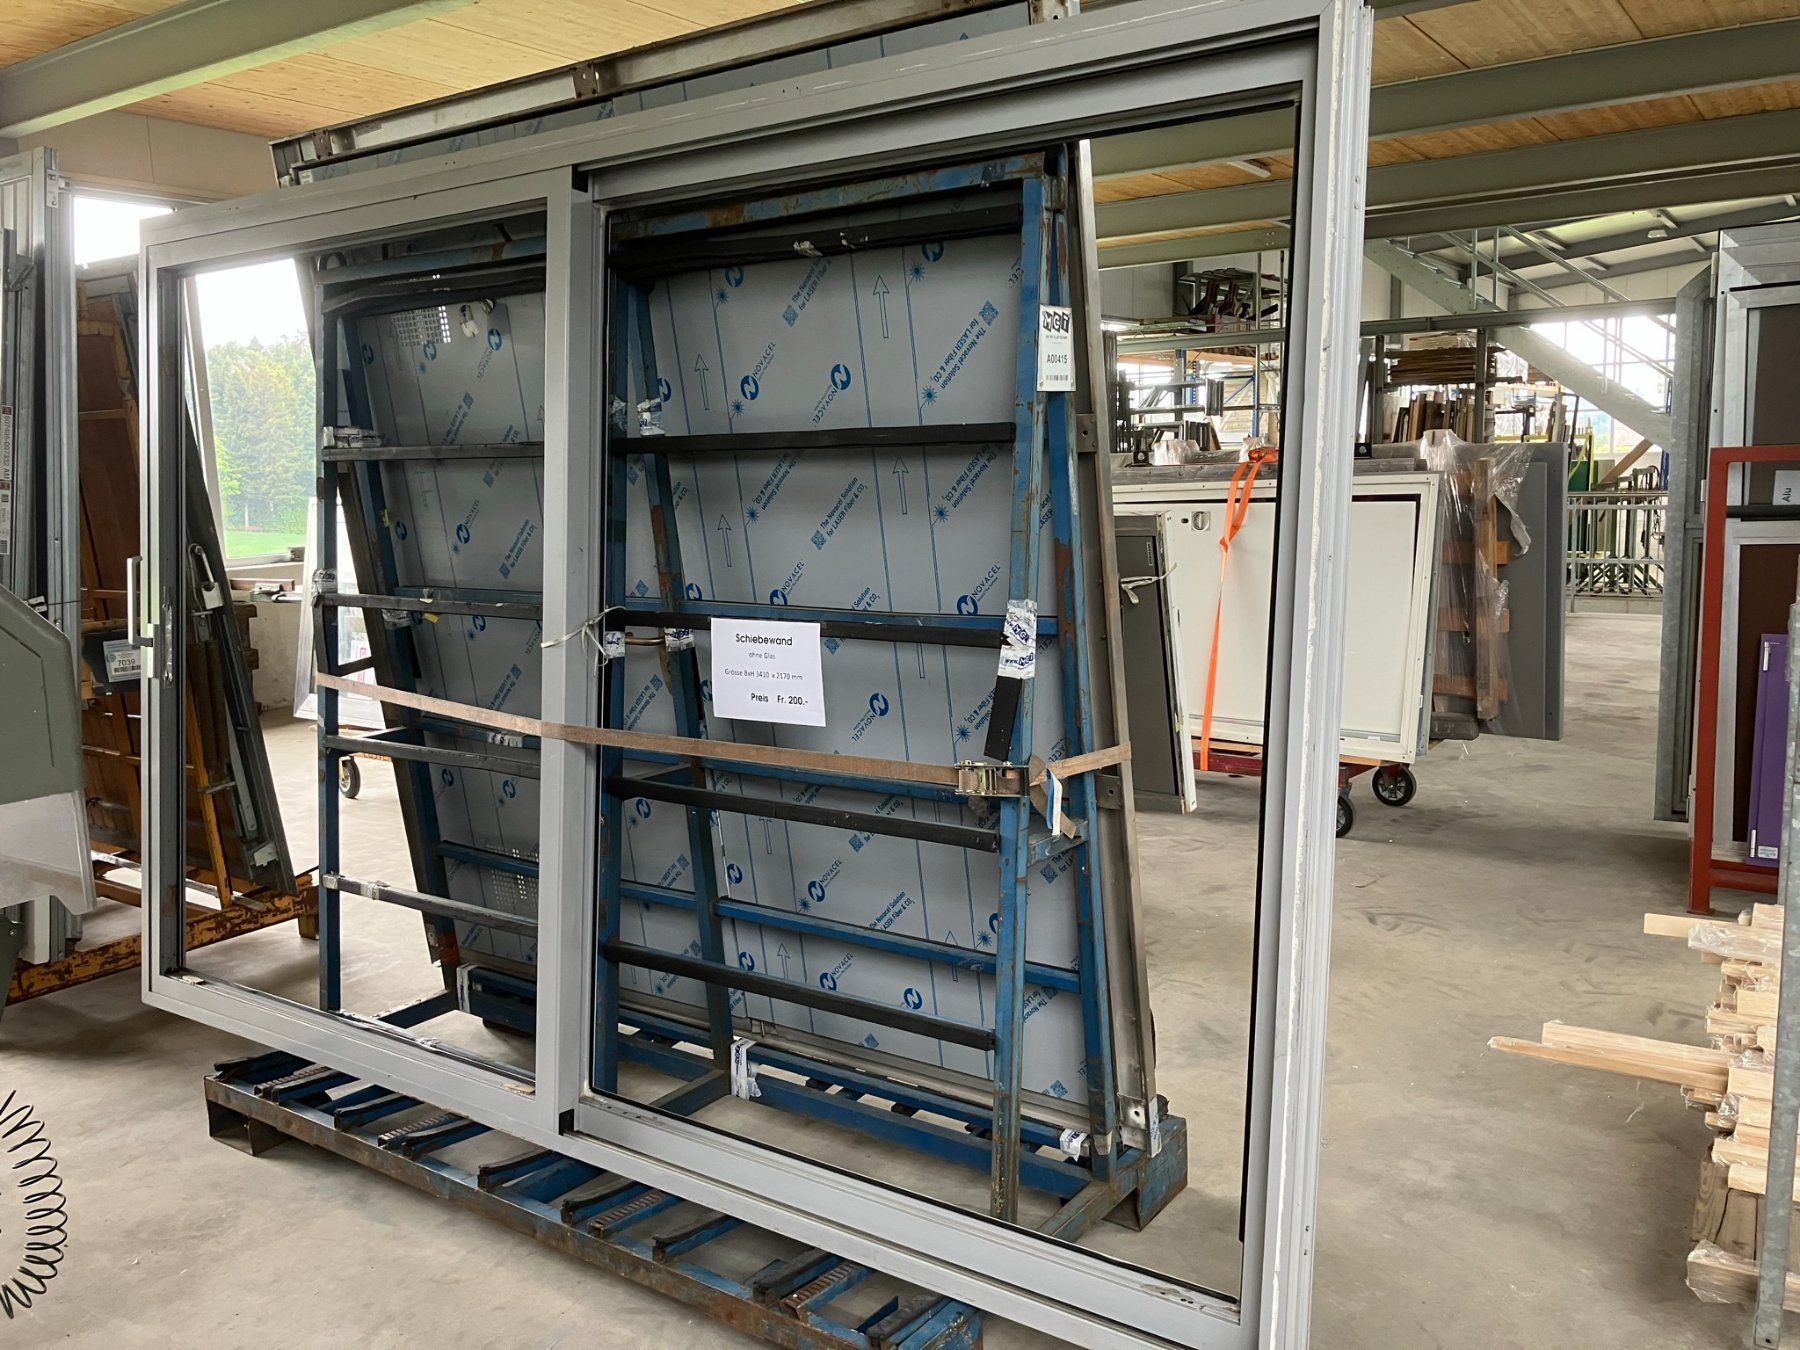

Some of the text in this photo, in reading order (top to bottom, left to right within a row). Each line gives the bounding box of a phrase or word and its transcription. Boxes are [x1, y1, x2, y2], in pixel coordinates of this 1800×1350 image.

[969, 318, 979, 330] for
[954, 328, 972, 352] LASER
[752, 341, 777, 378] NOVACEL
[940, 327, 987, 390] The Novacel Solution
[944, 349, 958, 366] Fiber
[812, 388, 838, 424] NOVACEL
[956, 470, 969, 487] Fiber
[972, 462, 989, 487] Novacel
[820, 477, 859, 529] The Novacel Solution
[951, 483, 973, 509] Solution
[1781, 487, 1792, 503] Alu
[833, 511, 847, 530] LASER
[844, 497, 857, 513] Fiber
[781, 561, 805, 593] NOVACEL
[971, 564, 1001, 598] NOVACEL
[853, 586, 870, 608] Solution
[735, 633, 793, 646] Schiebewand
[117, 658, 136, 666] 7039
[749, 652, 776, 660] ohne Glas
[777, 672, 791, 680] 2170
[751, 692, 809, 706] Preis Fr. 200.-
[851, 711, 877, 742] NOVACEL
[819, 859, 843, 885] NOVACEL
[876, 903, 891, 922] Novacel
[889, 891, 906, 909] Solution
[831, 952, 854, 977] NOVACEL
